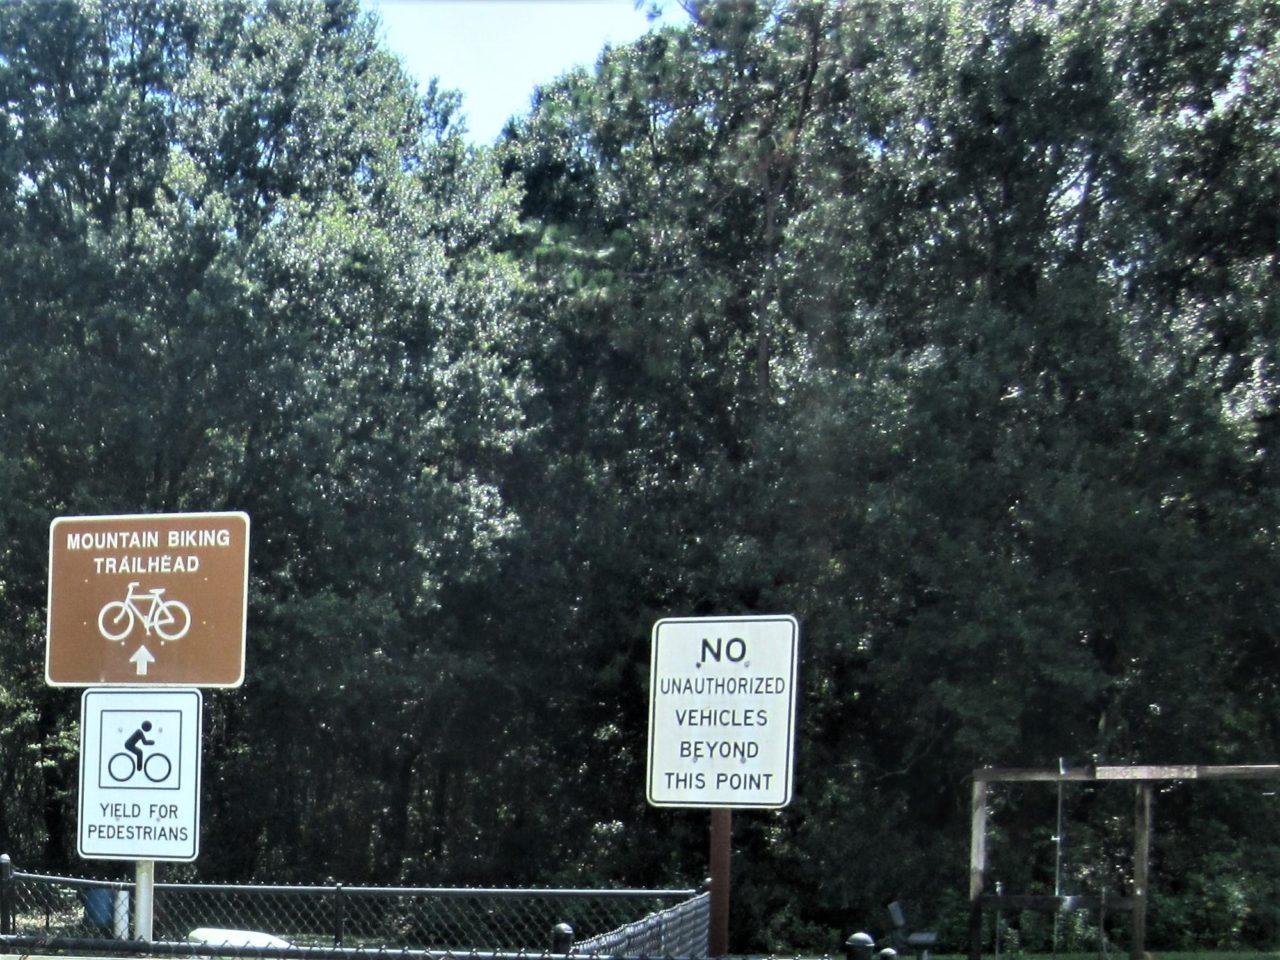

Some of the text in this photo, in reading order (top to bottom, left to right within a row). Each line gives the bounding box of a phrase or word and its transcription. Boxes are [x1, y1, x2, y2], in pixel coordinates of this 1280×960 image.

[66, 529, 230, 550] MOUNTAIN BIKING
[94, 555, 200, 574] TRAILHEAD
[701, 637, 746, 663] NO
[660, 677, 786, 694] UNAUTHORIZED
[675, 709, 768, 727] VEHICLES
[680, 741, 759, 758] BEYOND
[665, 772, 773, 791] THIS POINT
[100, 803, 178, 819] YIELD FOR
[88, 824, 188, 841] PEDESTRIANS
